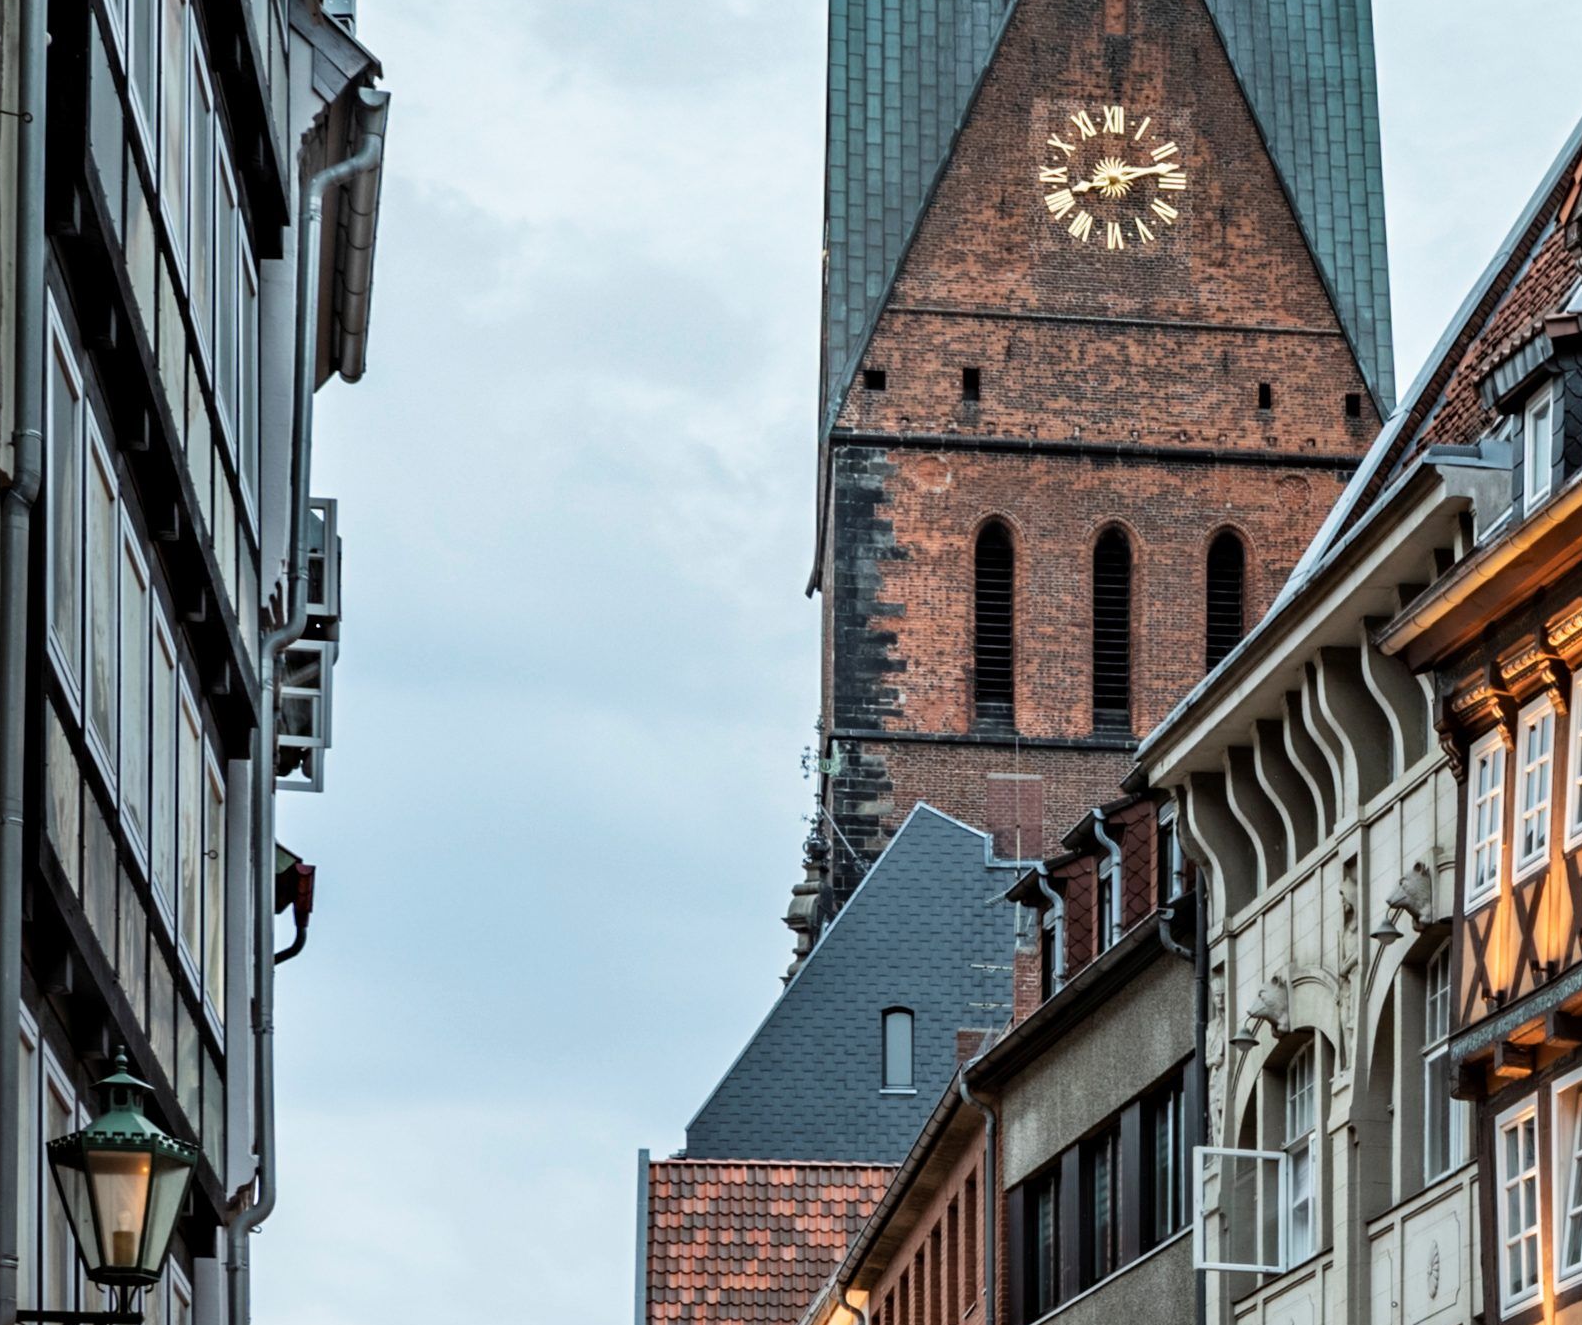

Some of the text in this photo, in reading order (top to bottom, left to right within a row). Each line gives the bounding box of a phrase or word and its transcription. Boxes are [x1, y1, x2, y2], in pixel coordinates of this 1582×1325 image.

[1069, 109, 1098, 141] XI
[1102, 105, 1125, 135] XII
[1134, 116, 1151, 141] I
[1047, 132, 1076, 158] X
[1150, 141, 1179, 162] II
